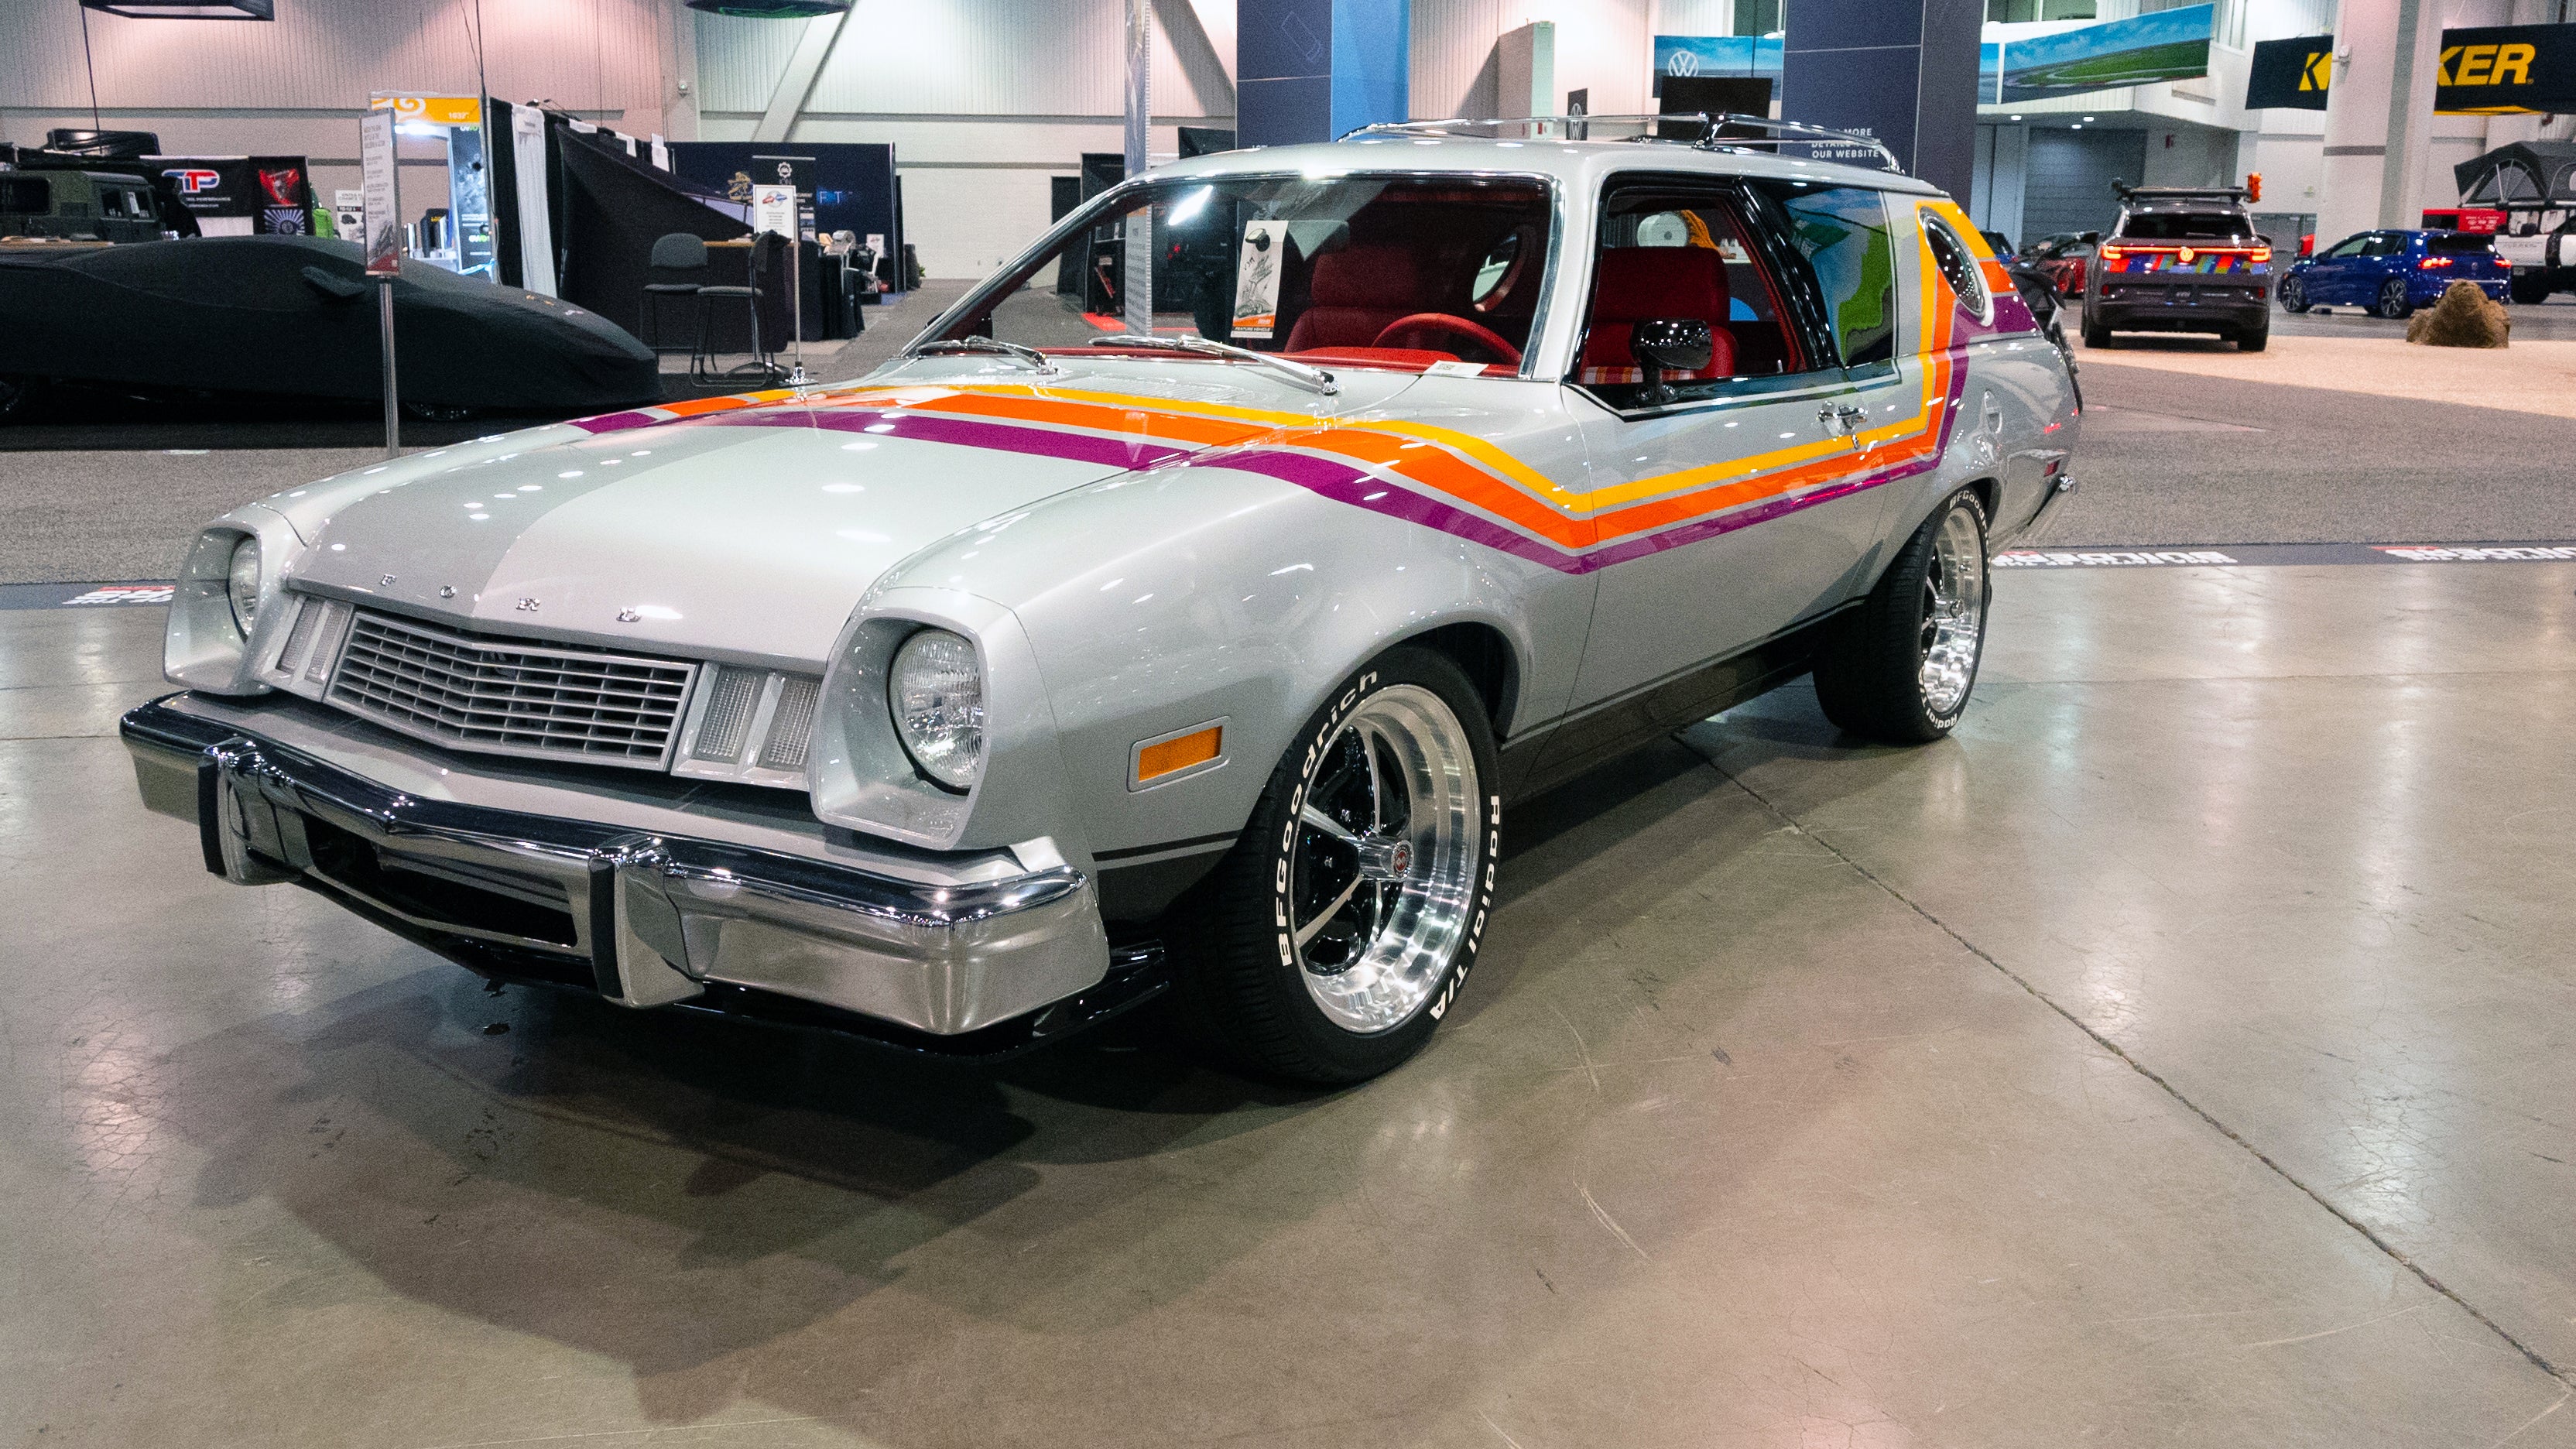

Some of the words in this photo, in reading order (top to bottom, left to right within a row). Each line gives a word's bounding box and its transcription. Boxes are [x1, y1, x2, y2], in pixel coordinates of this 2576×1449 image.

[1812, 150, 1832, 159] OUR
[1835, 149, 1879, 158] WEBSITE
[1276, 670, 1378, 967] BFGoodrich
[1468, 795, 1501, 956] Radial
[1429, 964, 1468, 1021] T/A
